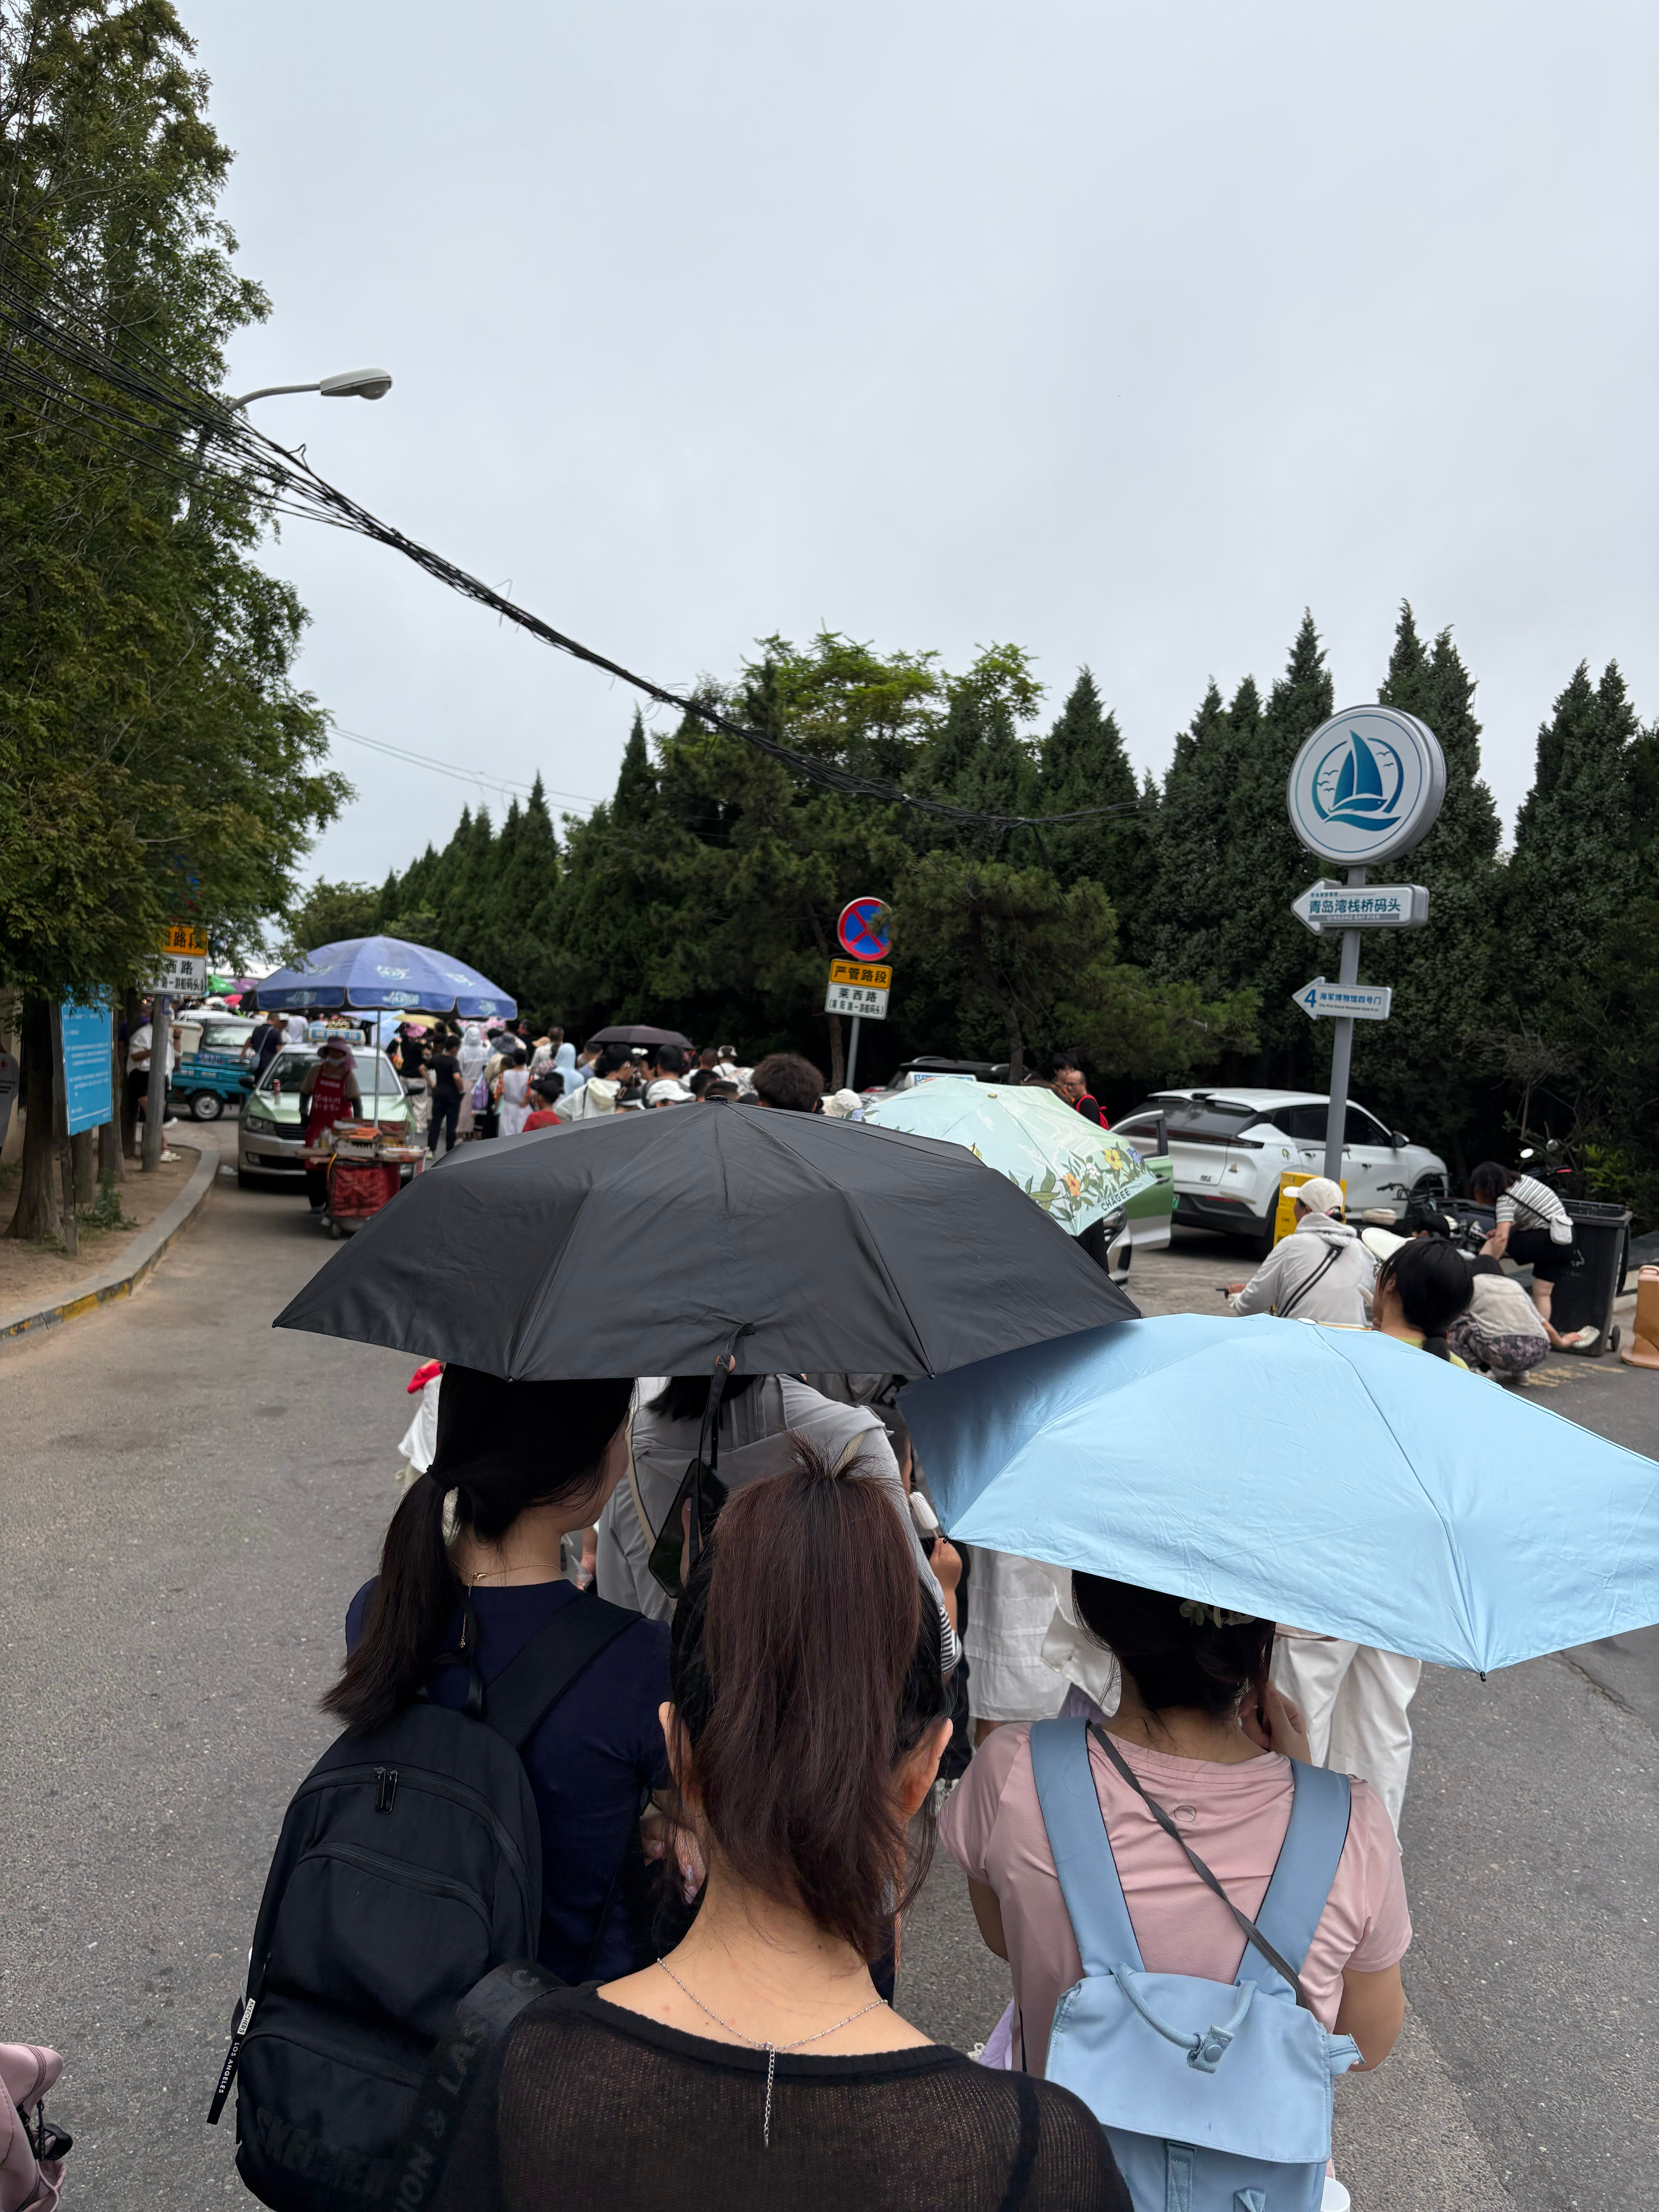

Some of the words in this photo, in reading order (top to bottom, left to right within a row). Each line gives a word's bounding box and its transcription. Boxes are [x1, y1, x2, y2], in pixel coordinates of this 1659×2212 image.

[1309, 898, 1400, 914] 青岛湾栈桥码头
[834, 966, 886, 983] 严管路段
[838, 988, 877, 1003] 莱西路
[1304, 989, 1316, 1008] 4
[1320, 992, 1381, 1005] 海军博物馆四号门
[1101, 1188, 1130, 1211] CHAGEE
[239, 2001, 254, 2033] SKECHERS
[231, 2042, 240, 2056] LOS
[219, 2059, 233, 2094] ANGELES
